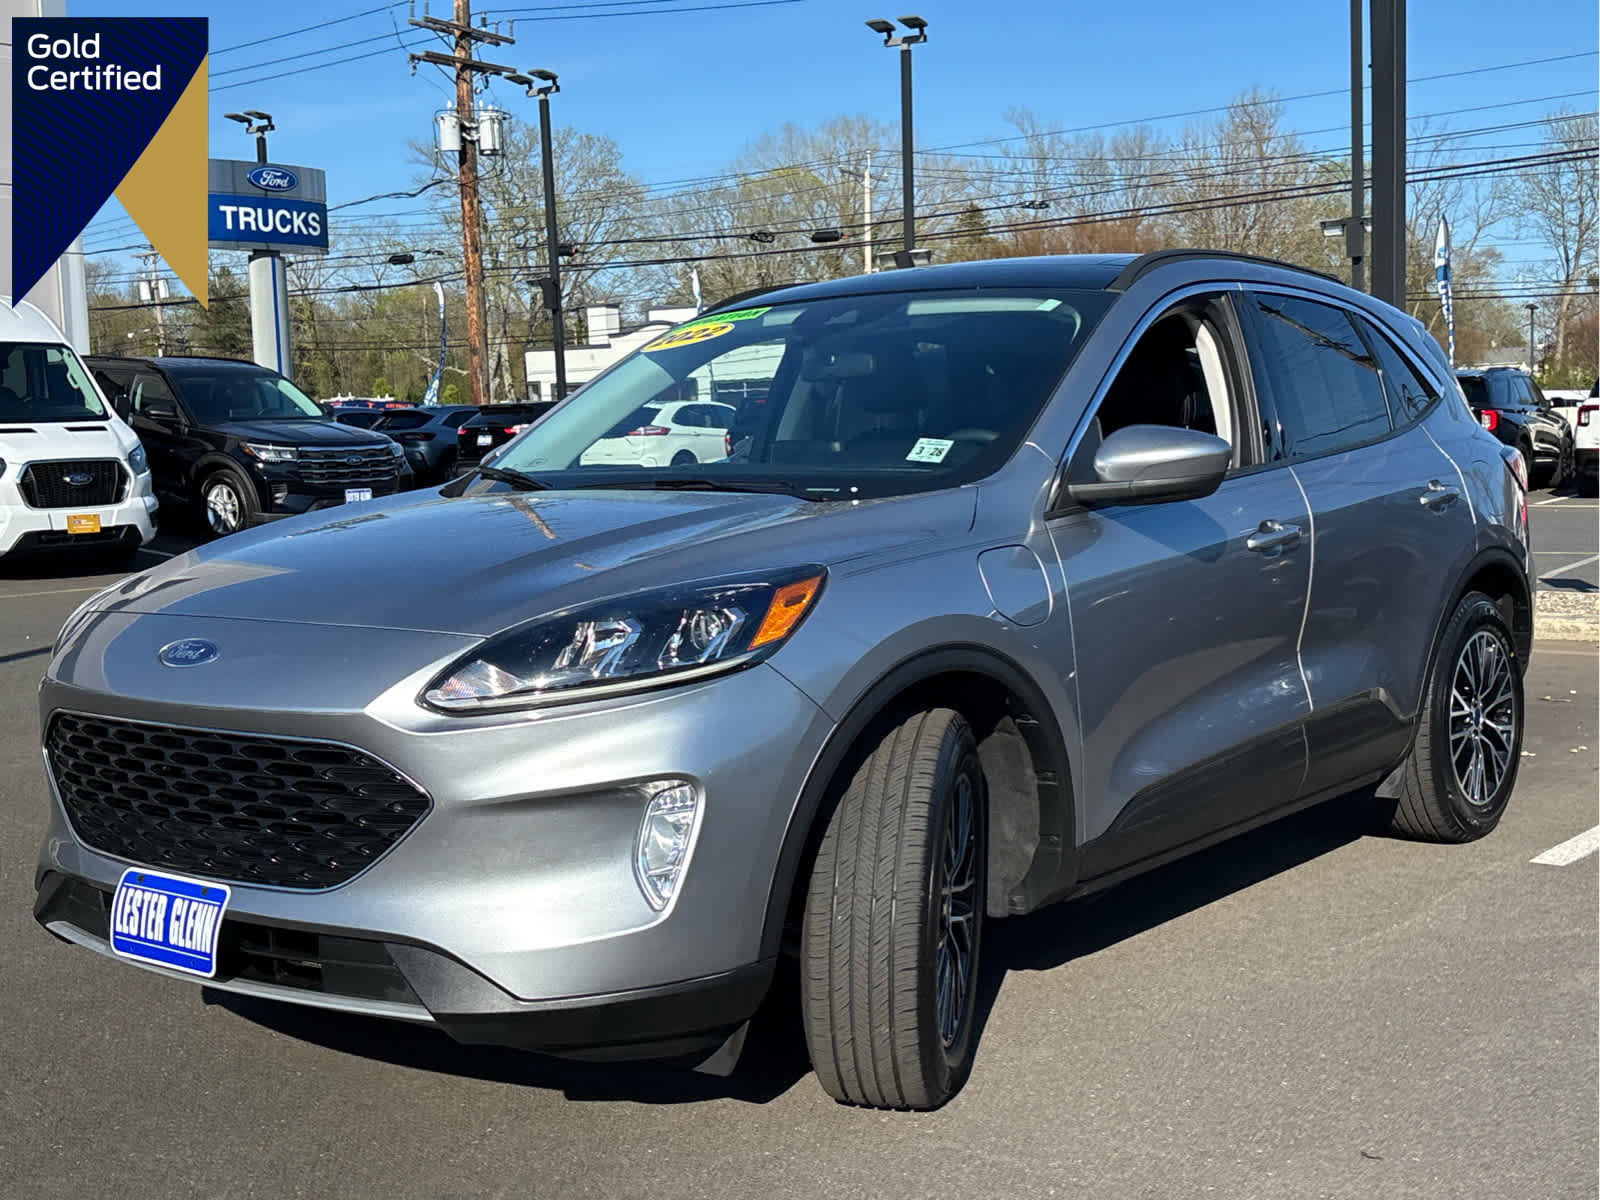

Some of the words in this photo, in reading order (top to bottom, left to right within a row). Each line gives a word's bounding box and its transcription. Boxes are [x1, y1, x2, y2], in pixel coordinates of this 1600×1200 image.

[259, 170, 290, 188] Ford
[218, 205, 321, 237] TRUCKS
[115, 886, 168, 942] LESTER
[169, 897, 219, 954] GLENN
